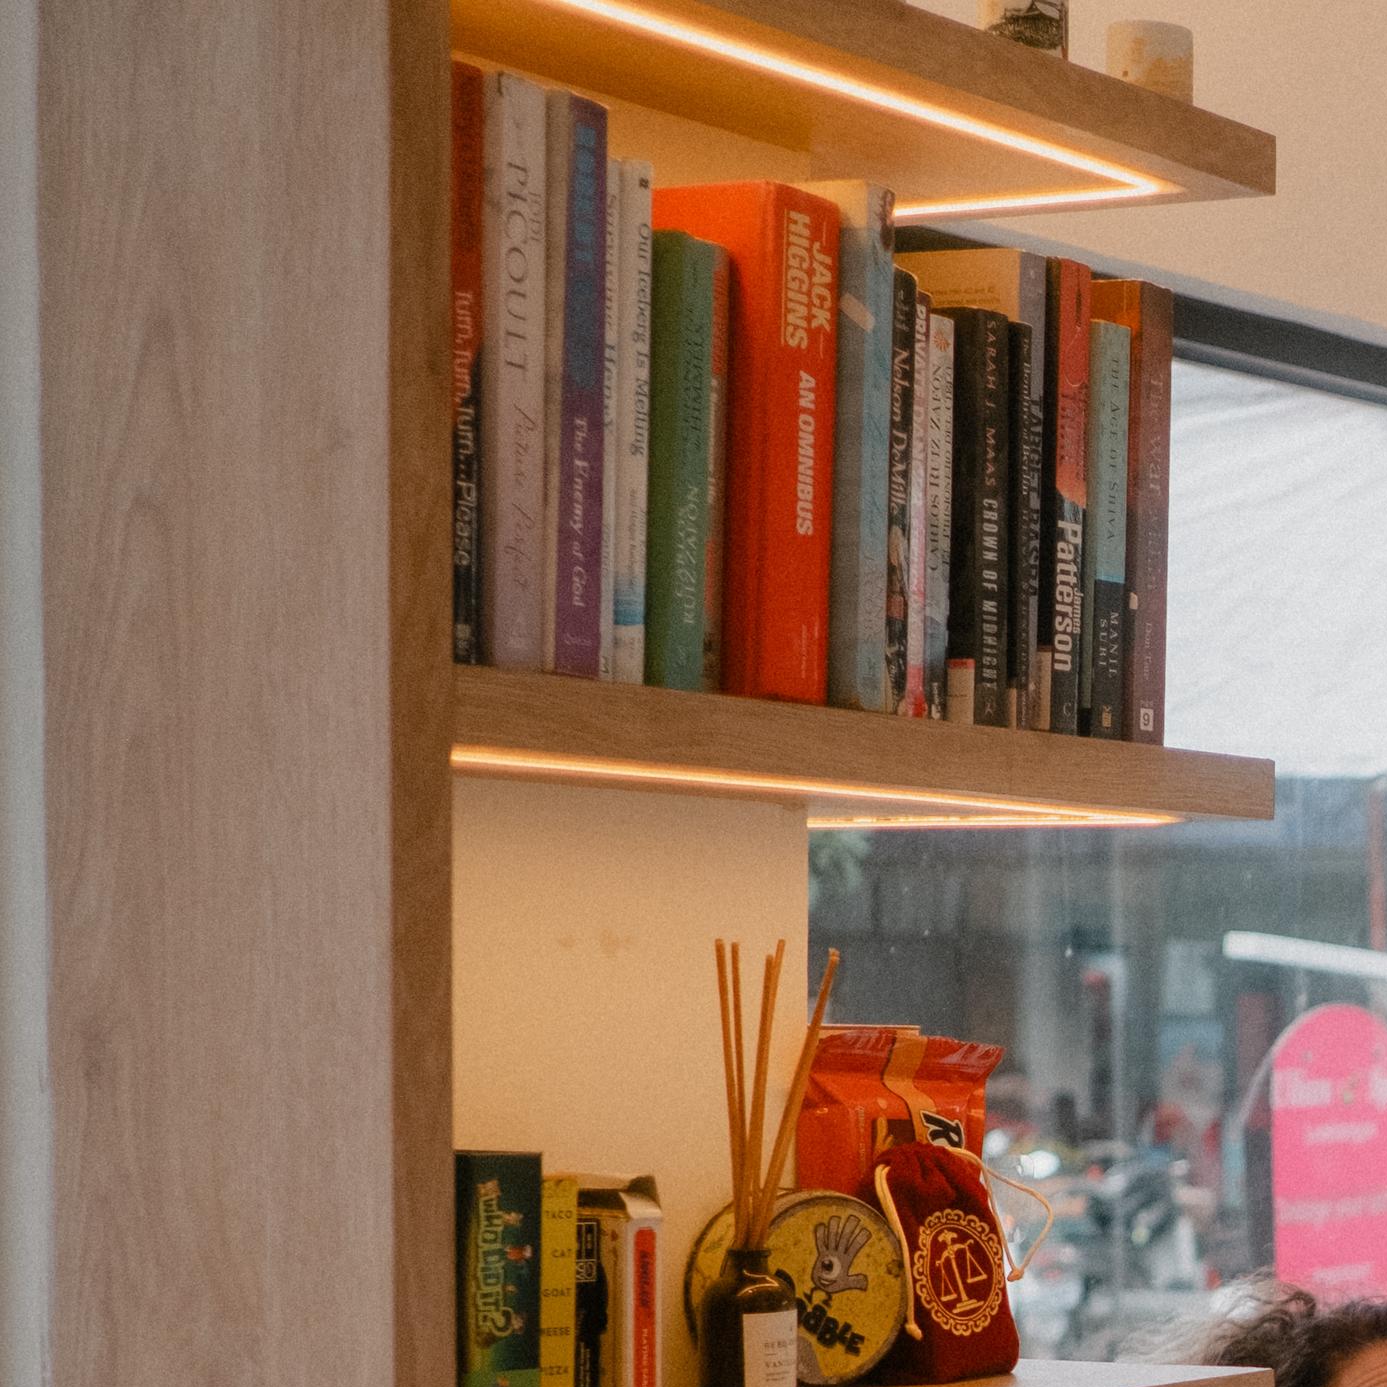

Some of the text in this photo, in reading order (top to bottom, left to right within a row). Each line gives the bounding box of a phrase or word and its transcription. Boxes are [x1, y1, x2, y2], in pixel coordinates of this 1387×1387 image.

[529, 191, 542, 245] JODI
[504, 160, 530, 383] PICOULT
[785, 210, 811, 350] HIGGINS
[811, 241, 833, 333] JACK
[630, 222, 650, 458] Our Iceberg Is Melting
[914, 304, 926, 398] PRIVATE
[985, 319, 998, 390] SARAH
[893, 346, 910, 423] Nelson
[795, 369, 816, 537] AN OMNIBUS
[889, 429, 909, 515] DeMille
[984, 427, 997, 487] MAAS
[455, 480, 477, 567] Please
[504, 402, 539, 593] Picture Perfect
[569, 416, 591, 608] The Enemy of God
[930, 494, 940, 572] CARLOS
[980, 498, 999, 689] CROWN OF MIDNIGHT
[1053, 520, 1082, 672] Patterson
[1072, 587, 1084, 635] James
[1098, 617, 1108, 668] SURI
[1108, 612, 1120, 679] MANIL
[551, 1248, 572, 1258] CAT
